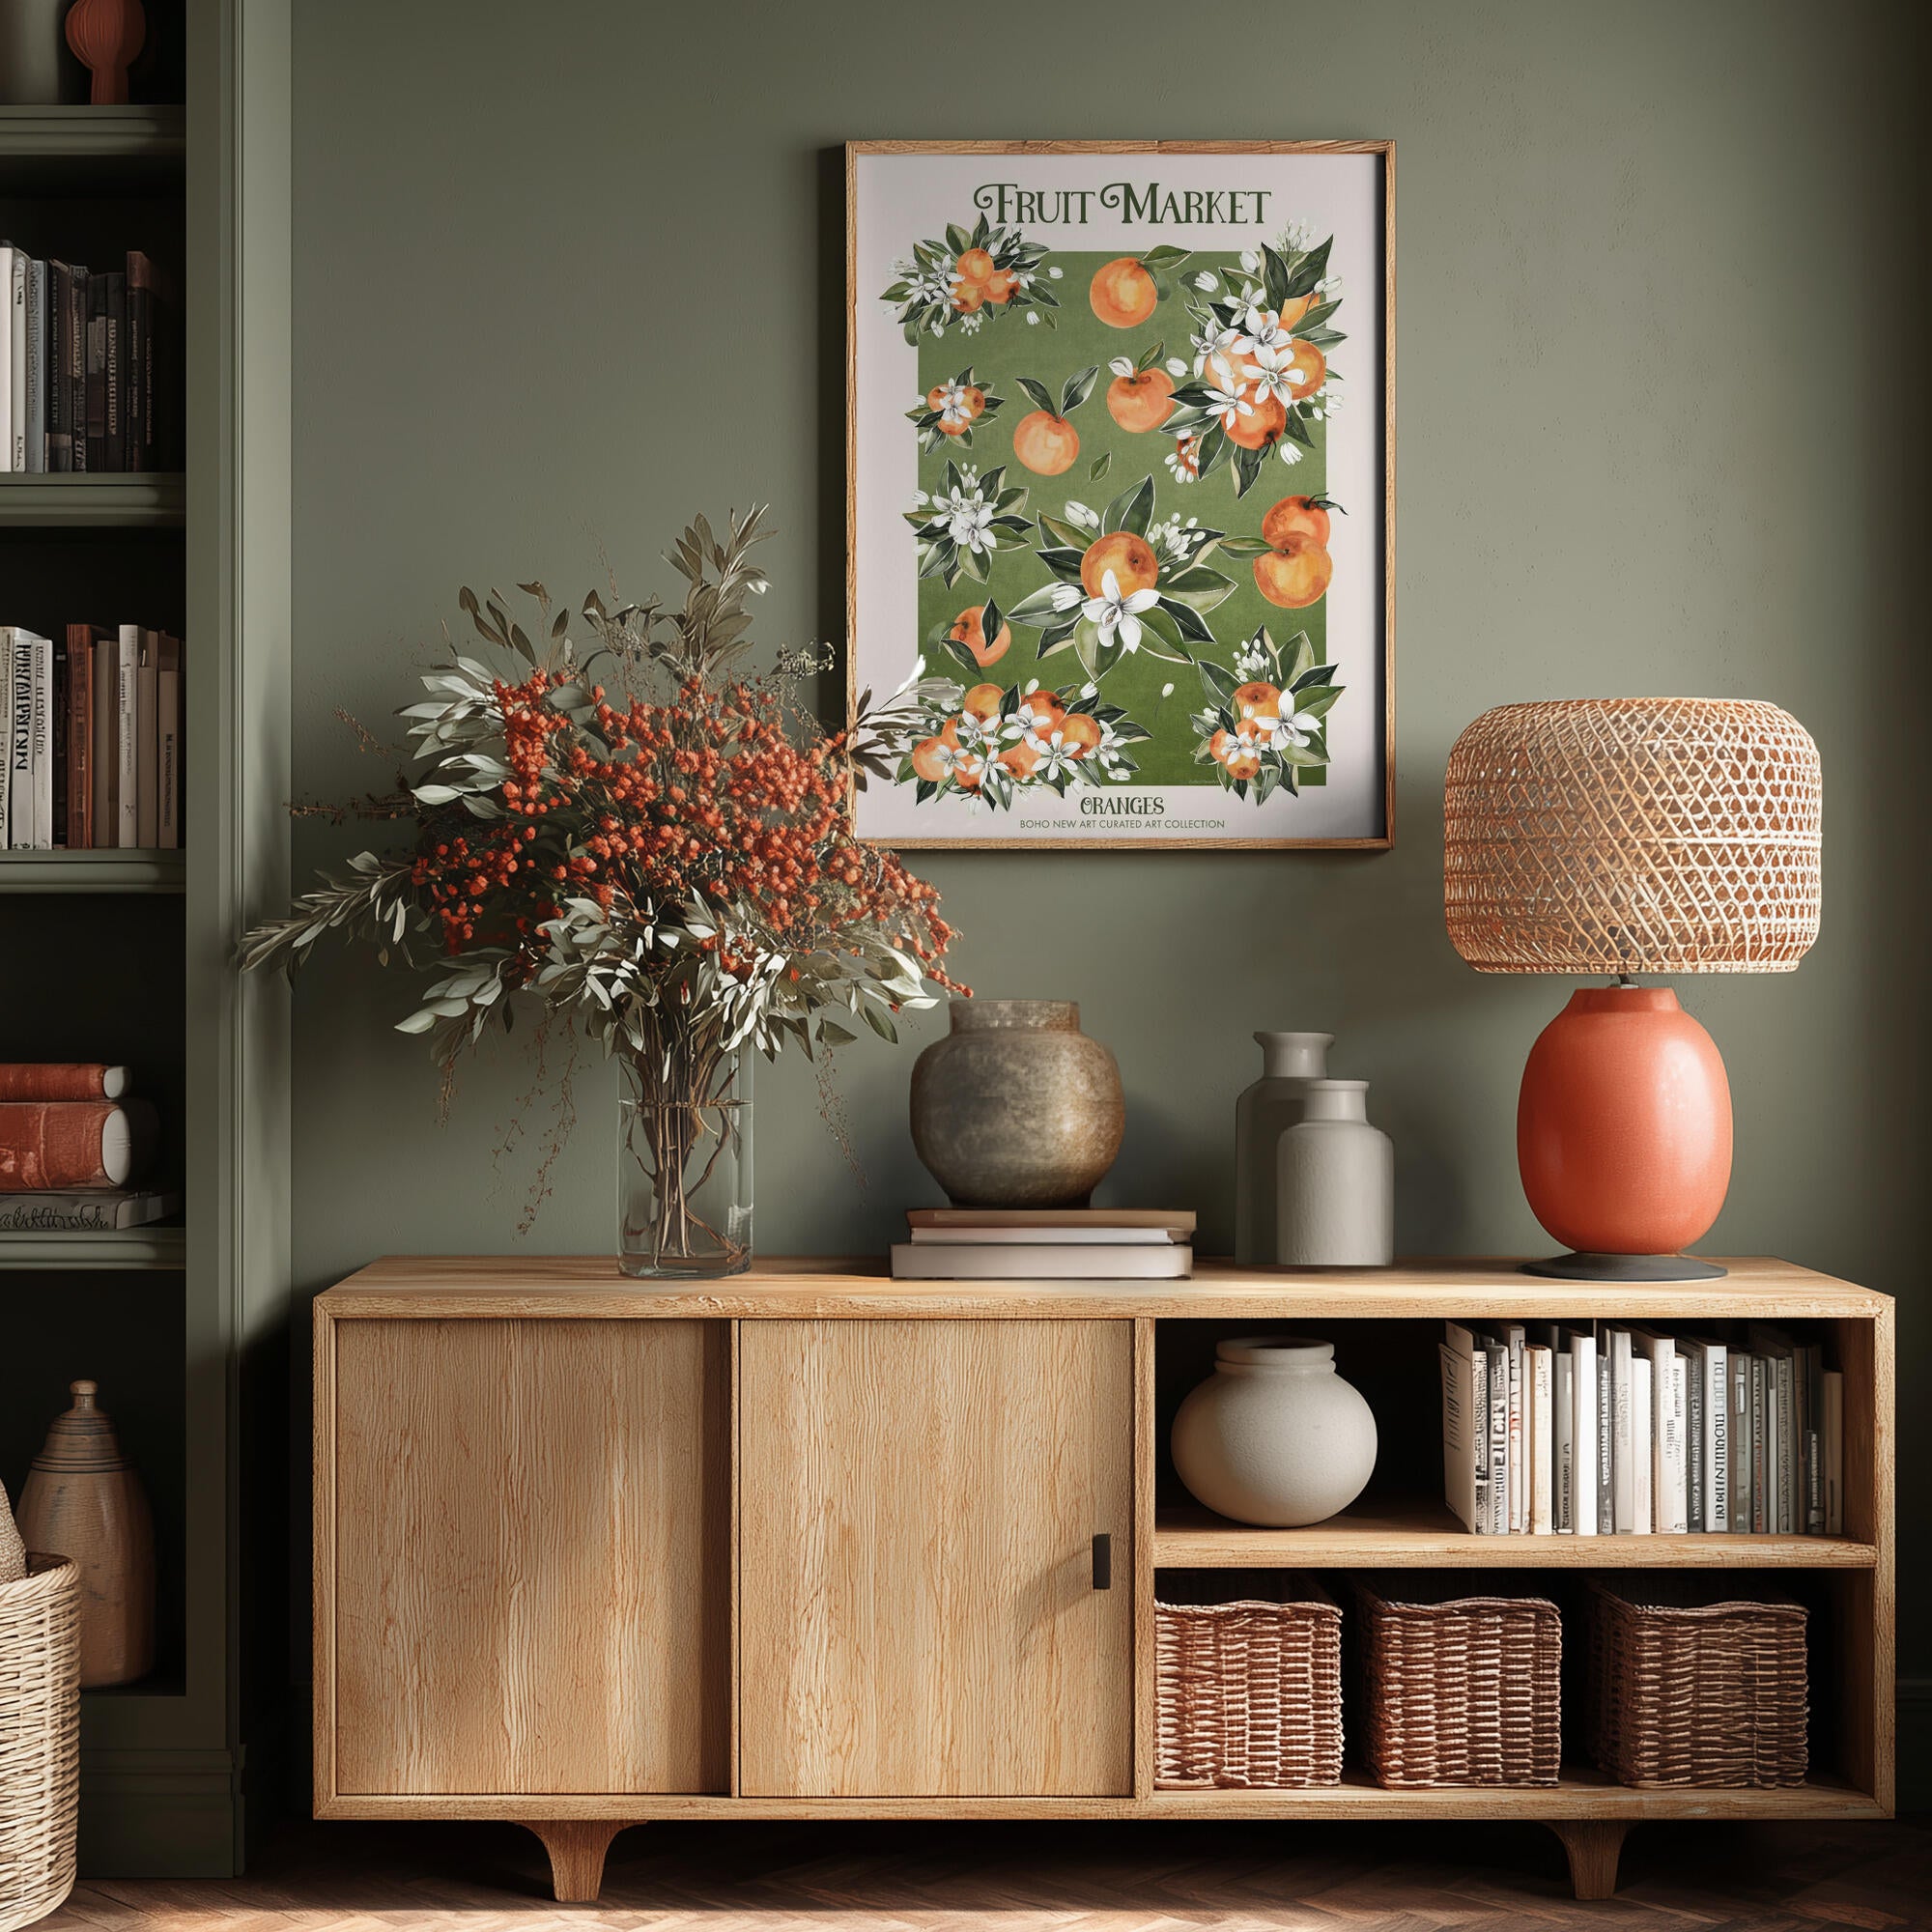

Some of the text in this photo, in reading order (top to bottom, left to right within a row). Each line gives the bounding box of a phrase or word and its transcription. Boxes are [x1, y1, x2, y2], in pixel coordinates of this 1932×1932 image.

[973, 183, 1272, 224] FRUIT MARKET
[1080, 796, 1165, 815] ORANGES
[1019, 819, 1225, 829] BOHO NEW ART CURATED ART COLLECTION
